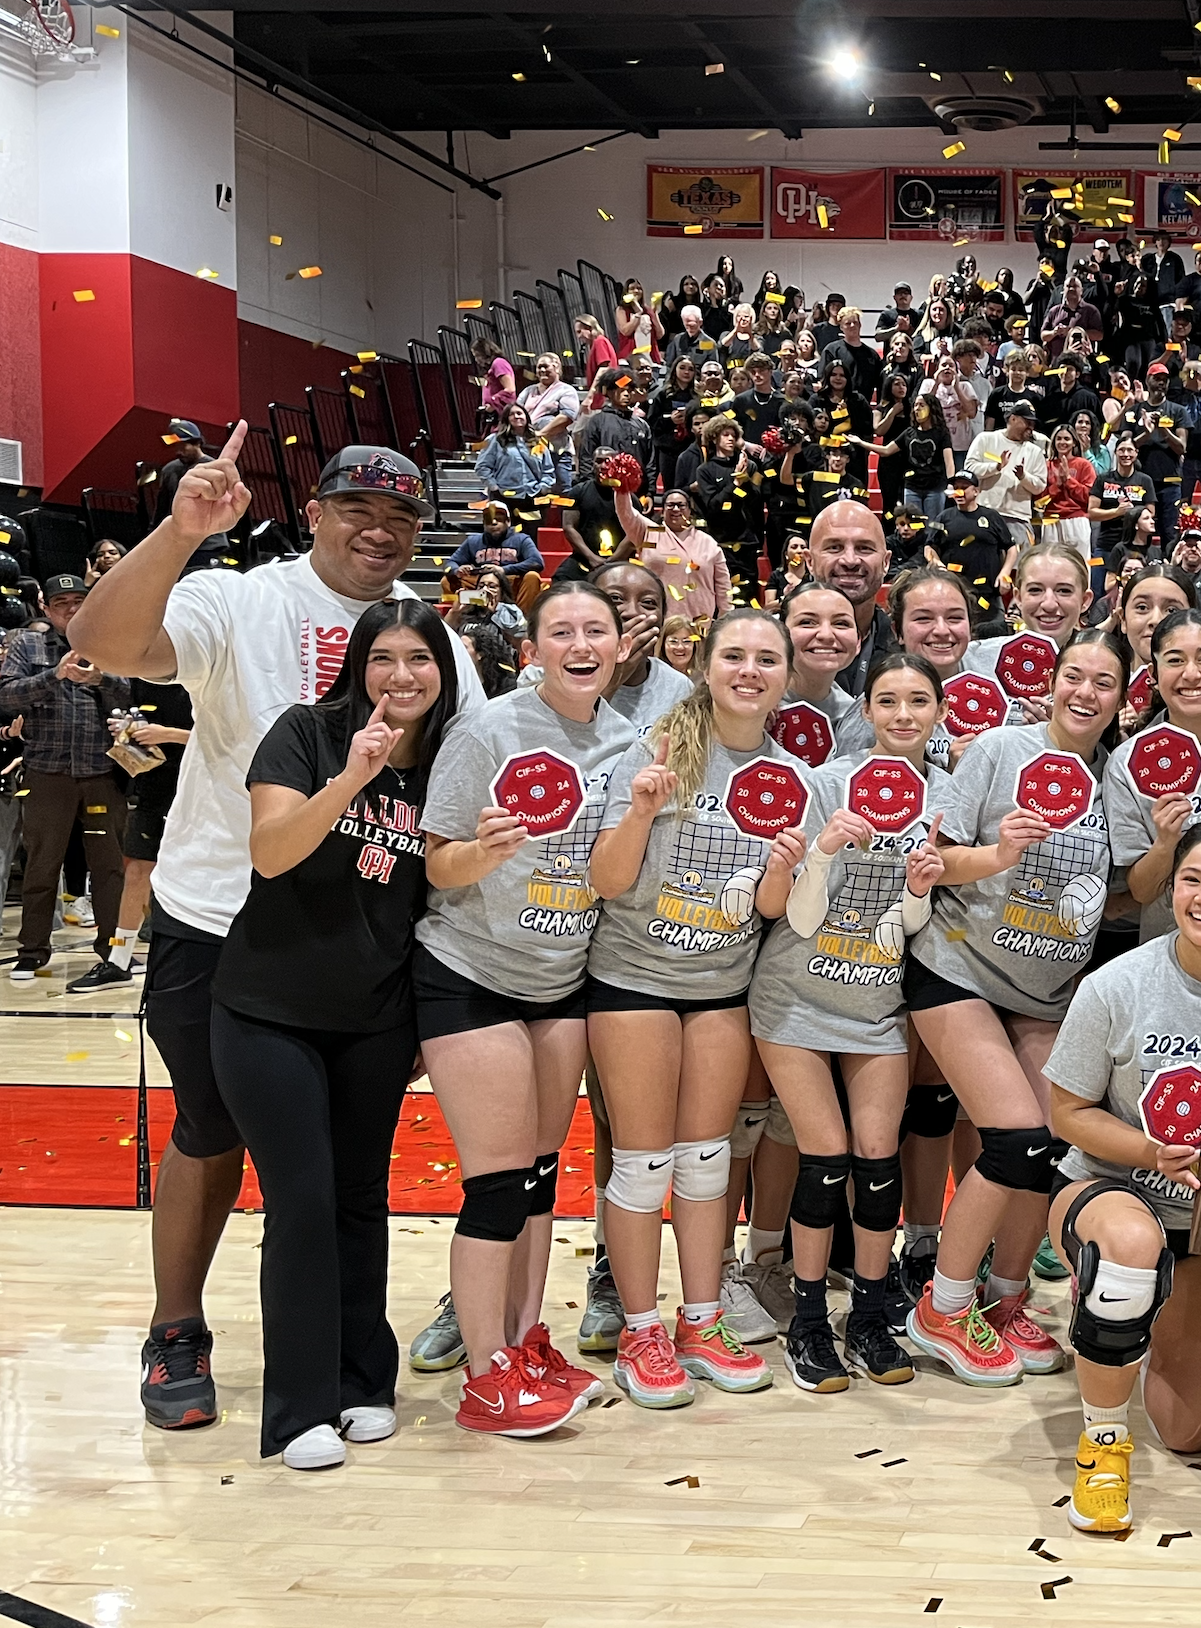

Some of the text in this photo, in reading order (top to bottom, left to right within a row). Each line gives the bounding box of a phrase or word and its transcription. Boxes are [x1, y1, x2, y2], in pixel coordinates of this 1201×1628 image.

[681, 191, 732, 205] TEXAS
[1022, 643, 1045, 655] CIF-SS
[299, 617, 310, 701] VOLLEYBALL
[1005, 656, 1014, 664] 20
[966, 682, 991, 695] CIF-SS
[1004, 671, 1045, 692] CHAMPIONS
[947, 694, 998, 716] 20 24
[948, 709, 990, 731] CHAMPIONS
[1144, 737, 1170, 753] CIF-SS
[516, 763, 547, 778] CIF-SS
[1044, 763, 1072, 775] CIF-SS
[1138, 749, 1191, 778] 20 24
[758, 771, 787, 785] CIF-SS
[873, 769, 901, 779] CIF-SS
[1150, 766, 1193, 790] CHAMPIONS
[506, 780, 570, 804] 20 24
[737, 788, 796, 809] 20 24
[857, 788, 915, 800] 20 24
[1026, 781, 1082, 797] 20 24
[516, 798, 572, 824] CHAMPIONS
[738, 806, 789, 827] CHAMPIONS
[860, 804, 911, 822] CHAMPIONS
[1028, 798, 1077, 817] CHAMPIONS
[357, 843, 397, 884] OH
[992, 927, 1091, 962] CHAMPIONS
[1154, 1083, 1175, 1111] CIF-SS
[1165, 1124, 1176, 1138] 20
